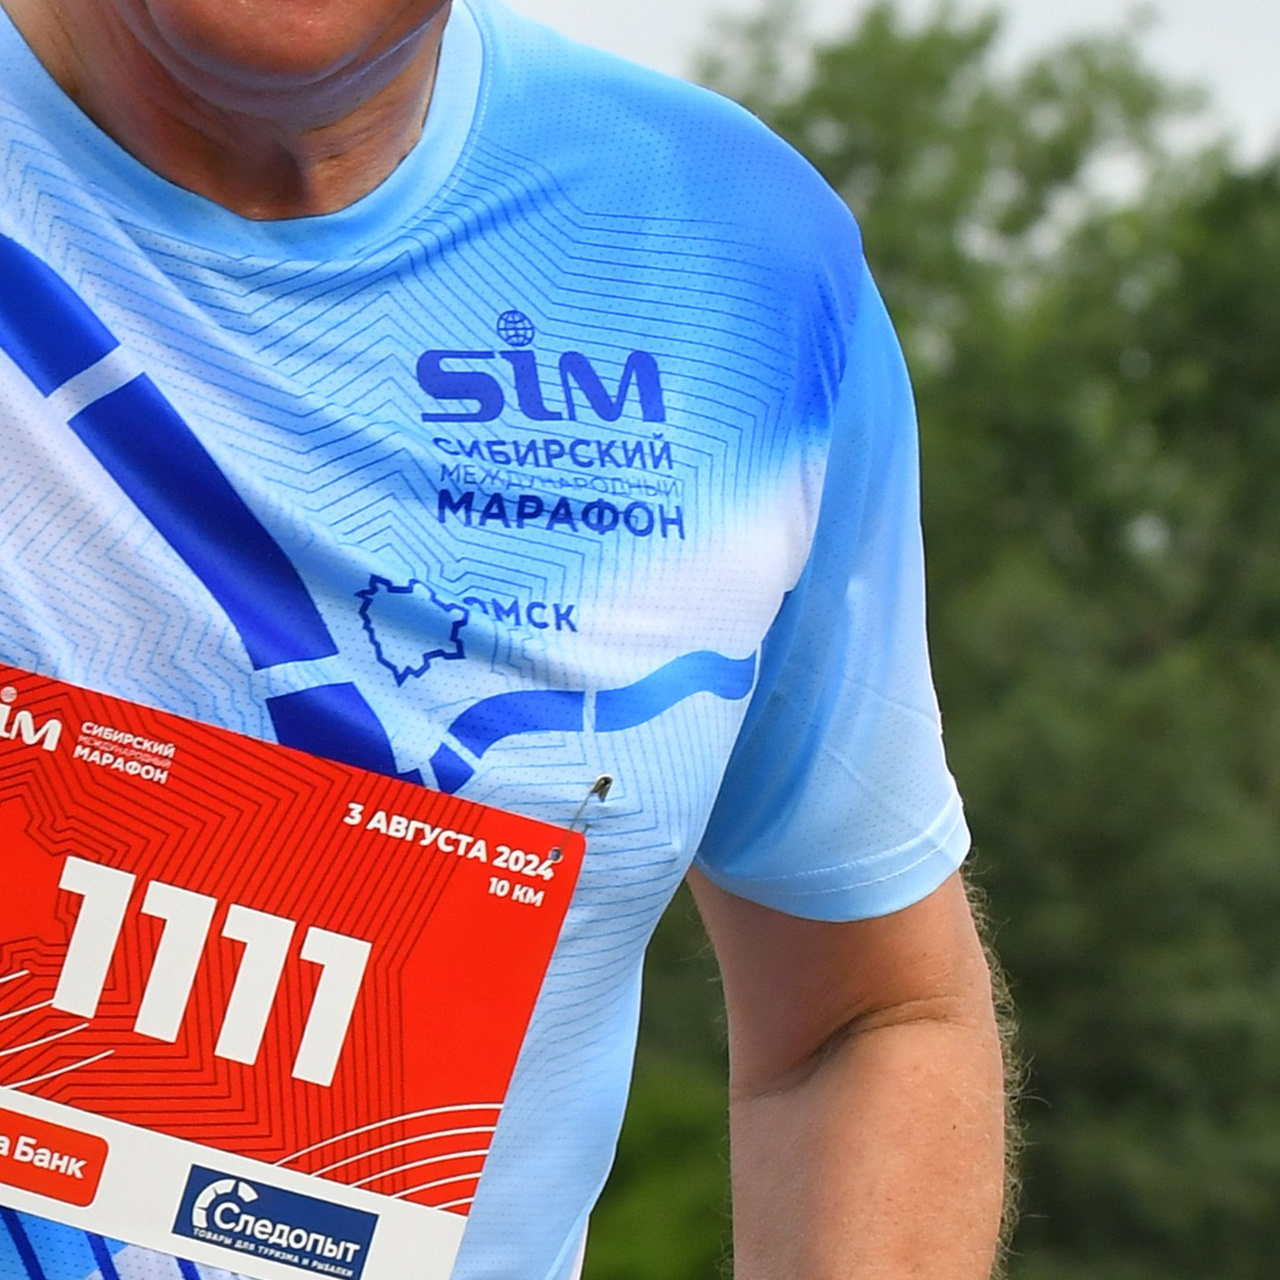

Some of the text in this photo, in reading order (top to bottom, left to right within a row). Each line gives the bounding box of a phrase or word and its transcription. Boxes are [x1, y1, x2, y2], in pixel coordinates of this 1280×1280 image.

[433, 433, 673, 470] СИБИРСКИЙ
[437, 489, 685, 540] МАРАФОН
[81, 721, 176, 758] СИБИРСКИЙ
[73, 744, 169, 785] МАРАФОН
[343, 802, 554, 880] 3 АВГУСТА 2024
[488, 877, 545, 907] 10 КМ
[51, 855, 373, 1087] 1111
[13, 1135, 88, 1179] Банк
[193, 1227, 354, 1277] ТОВАРЫ ДЛЯ ТУРИЗМА И РЫБАЛКИ
[214, 1201, 360, 1263] Следопыт
